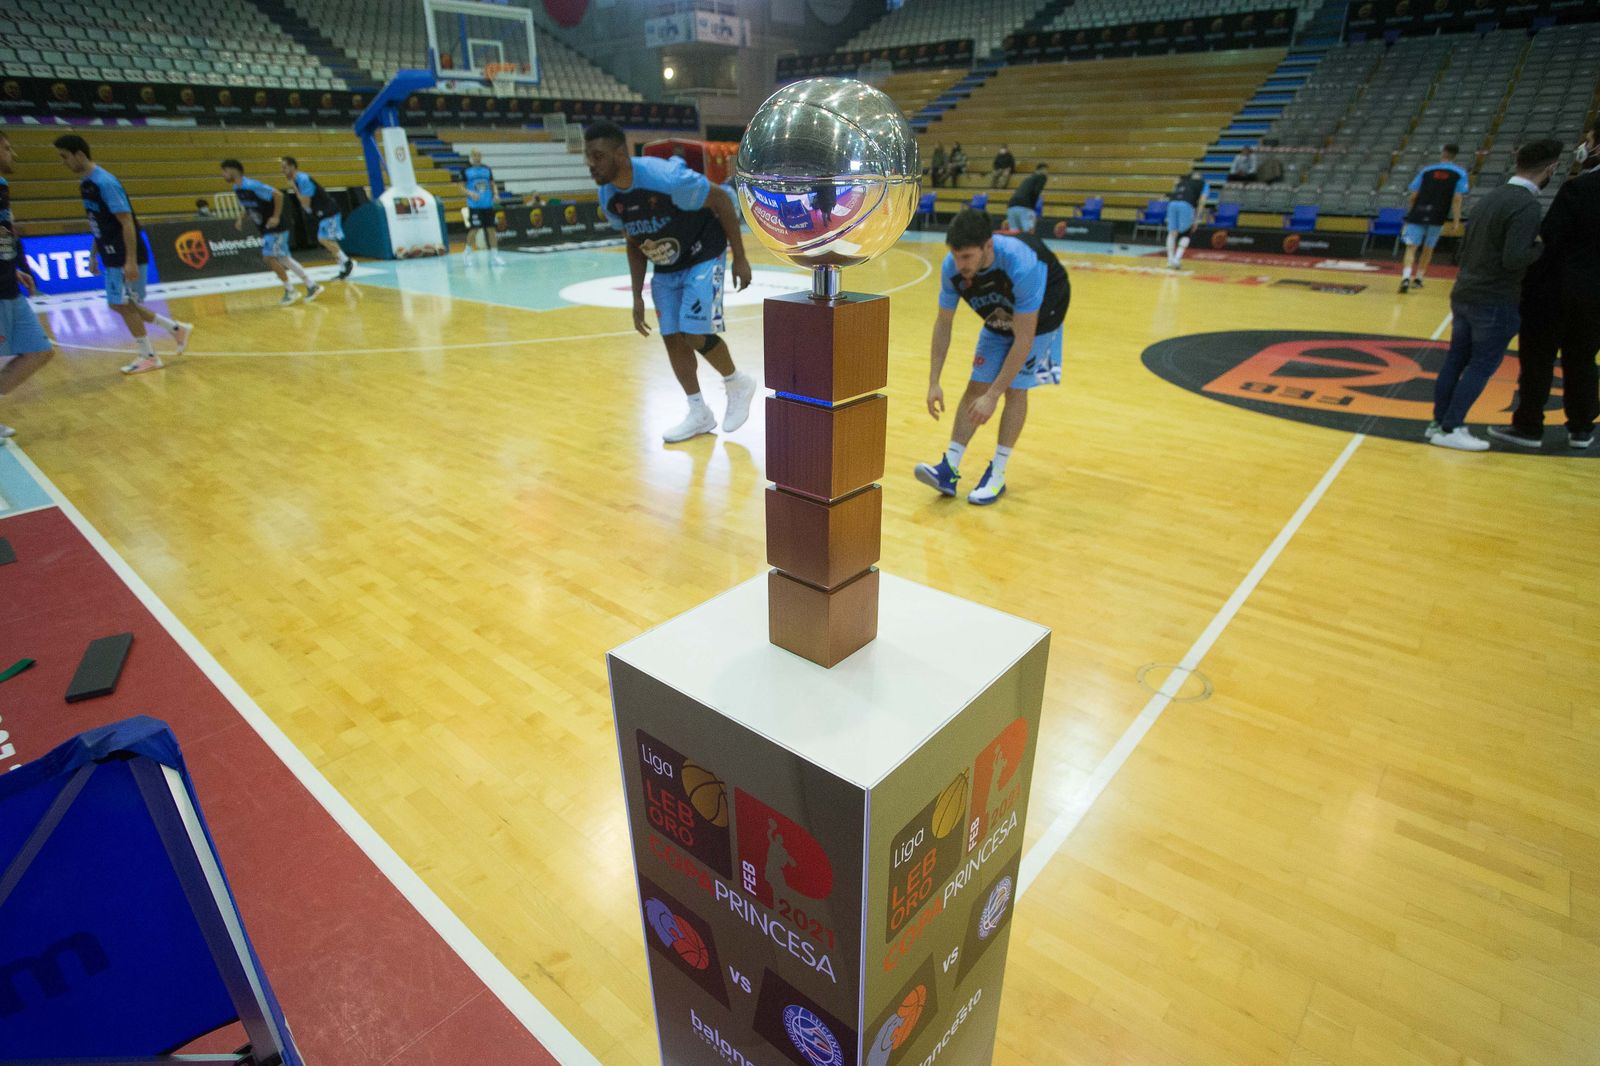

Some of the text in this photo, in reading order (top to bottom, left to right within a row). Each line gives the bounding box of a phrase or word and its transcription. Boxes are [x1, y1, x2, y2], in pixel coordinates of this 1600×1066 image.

[641, 743, 673, 779] Liga
[647, 779, 695, 828] LEB
[648, 805, 695, 847] ORO
[894, 827, 924, 869] Liga
[968, 816, 980, 853] FEB
[742, 860, 757, 896] FEB
[883, 895, 943, 973] COPA
[943, 810, 1017, 909] PRINCESA
[892, 847, 937, 910] LEB
[649, 833, 837, 984] COPA PRINCESA
[779, 898, 835, 950] 2021
[890, 876, 933, 930] ORO
